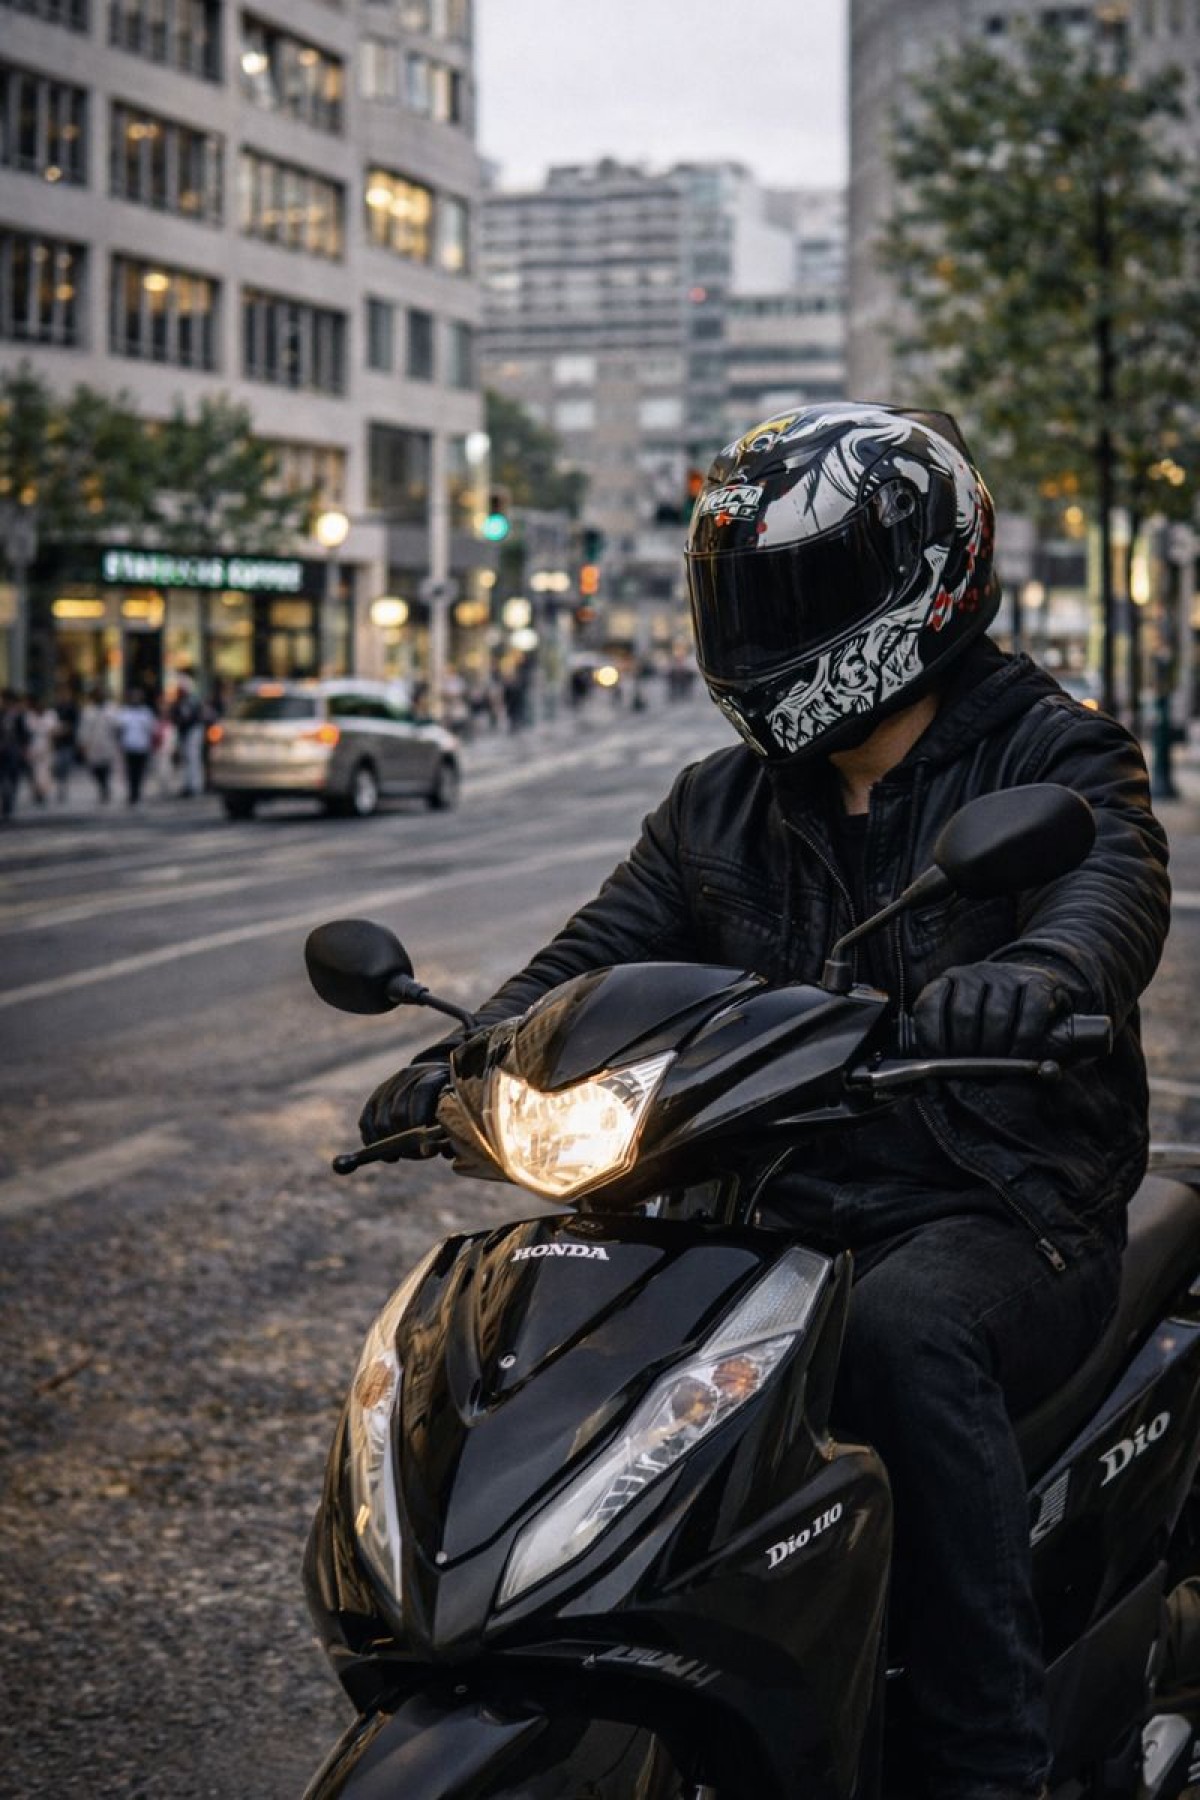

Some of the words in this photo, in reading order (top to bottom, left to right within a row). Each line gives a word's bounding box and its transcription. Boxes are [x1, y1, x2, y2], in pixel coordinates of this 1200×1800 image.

[510, 1243, 610, 1262] HONDA
[1098, 1411, 1170, 1487] Dio
[765, 1529, 810, 1570] Dio
[812, 1502, 843, 1537] 110
